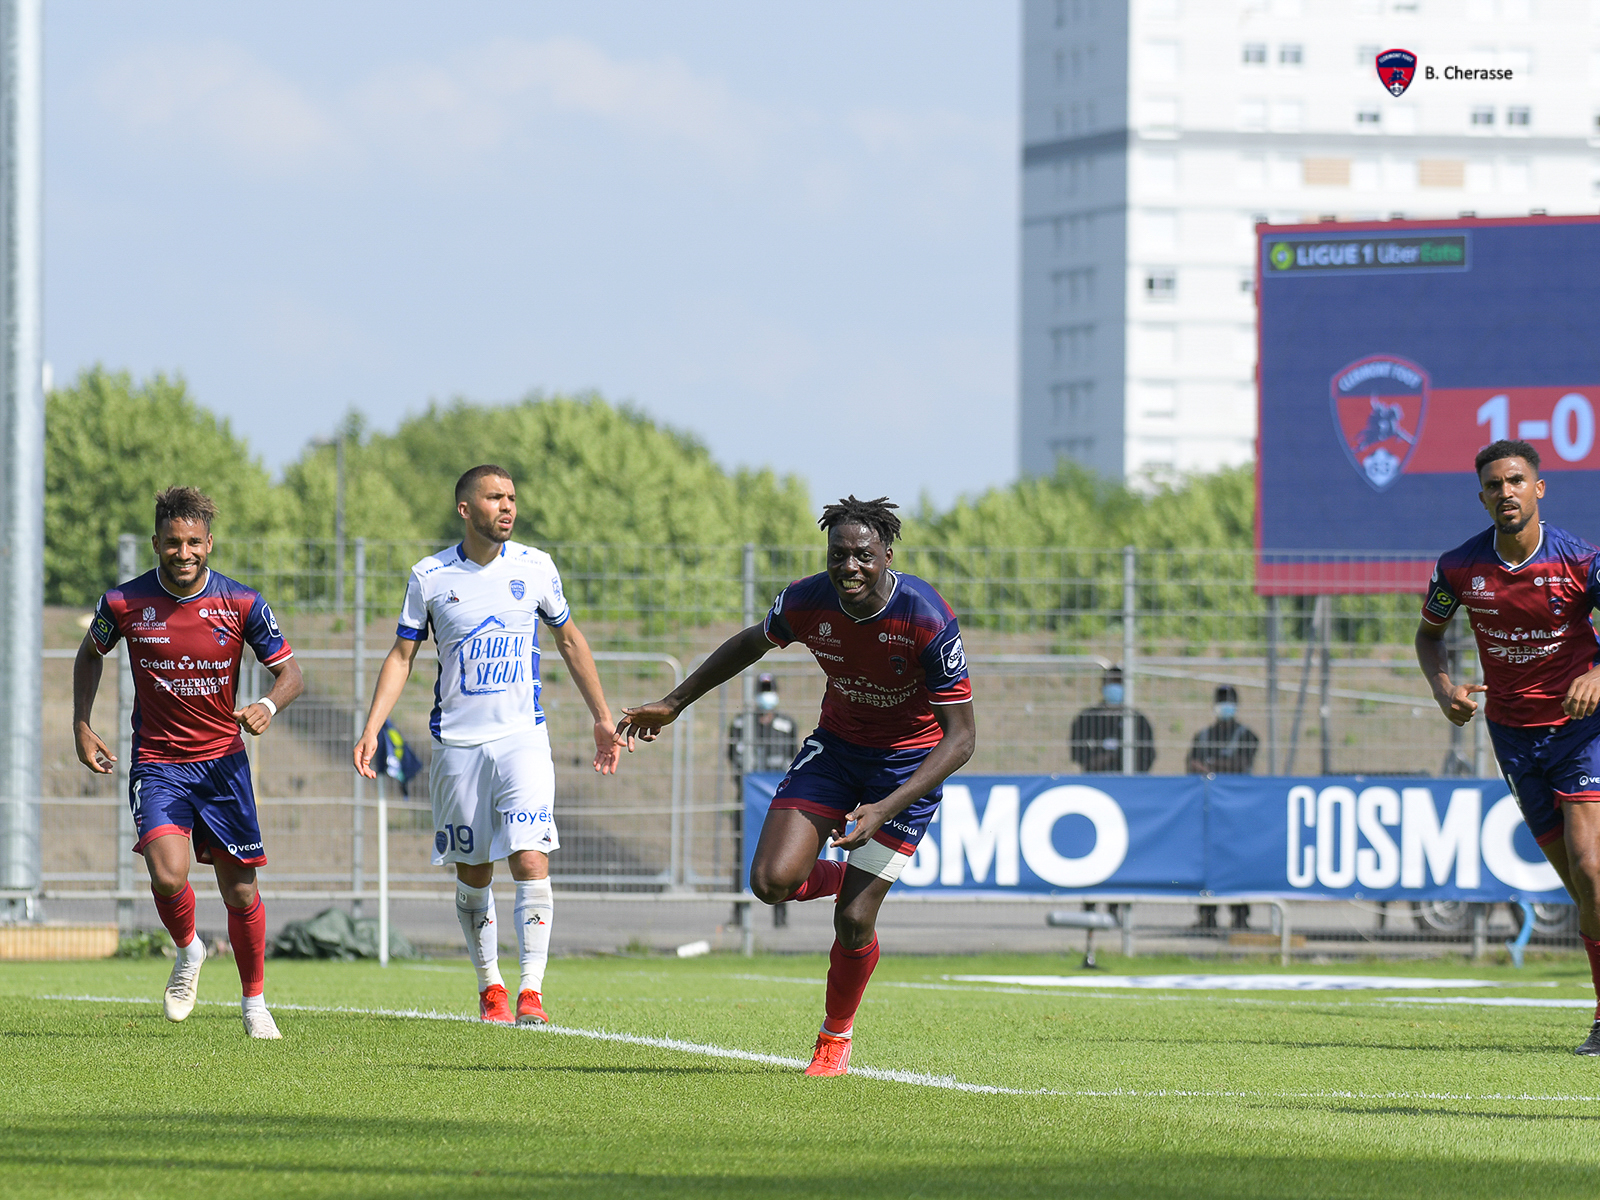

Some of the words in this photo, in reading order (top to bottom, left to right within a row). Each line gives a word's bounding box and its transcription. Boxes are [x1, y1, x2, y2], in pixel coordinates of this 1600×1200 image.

[1296, 243, 1361, 266] LIGUE
[1362, 243, 1375, 264] 1
[1377, 242, 1420, 264] Uber
[1420, 241, 1463, 262] Eats
[1476, 393, 1595, 462] 1-0
[139, 636, 171, 644] PATRICK
[469, 636, 525, 660] BABEAU
[140, 658, 176, 670] Crédit
[196, 657, 232, 670] Mutuel
[815, 650, 845, 662] PATRICK
[476, 660, 526, 686] SEGUIN
[172, 676, 230, 688] CLERMONT
[173, 686, 221, 697] FERRAND
[503, 811, 552, 825] Troyes
[892, 821, 919, 837] VEOLIA
[445, 824, 475, 854] 19
[1286, 785, 1567, 892] COSMO
